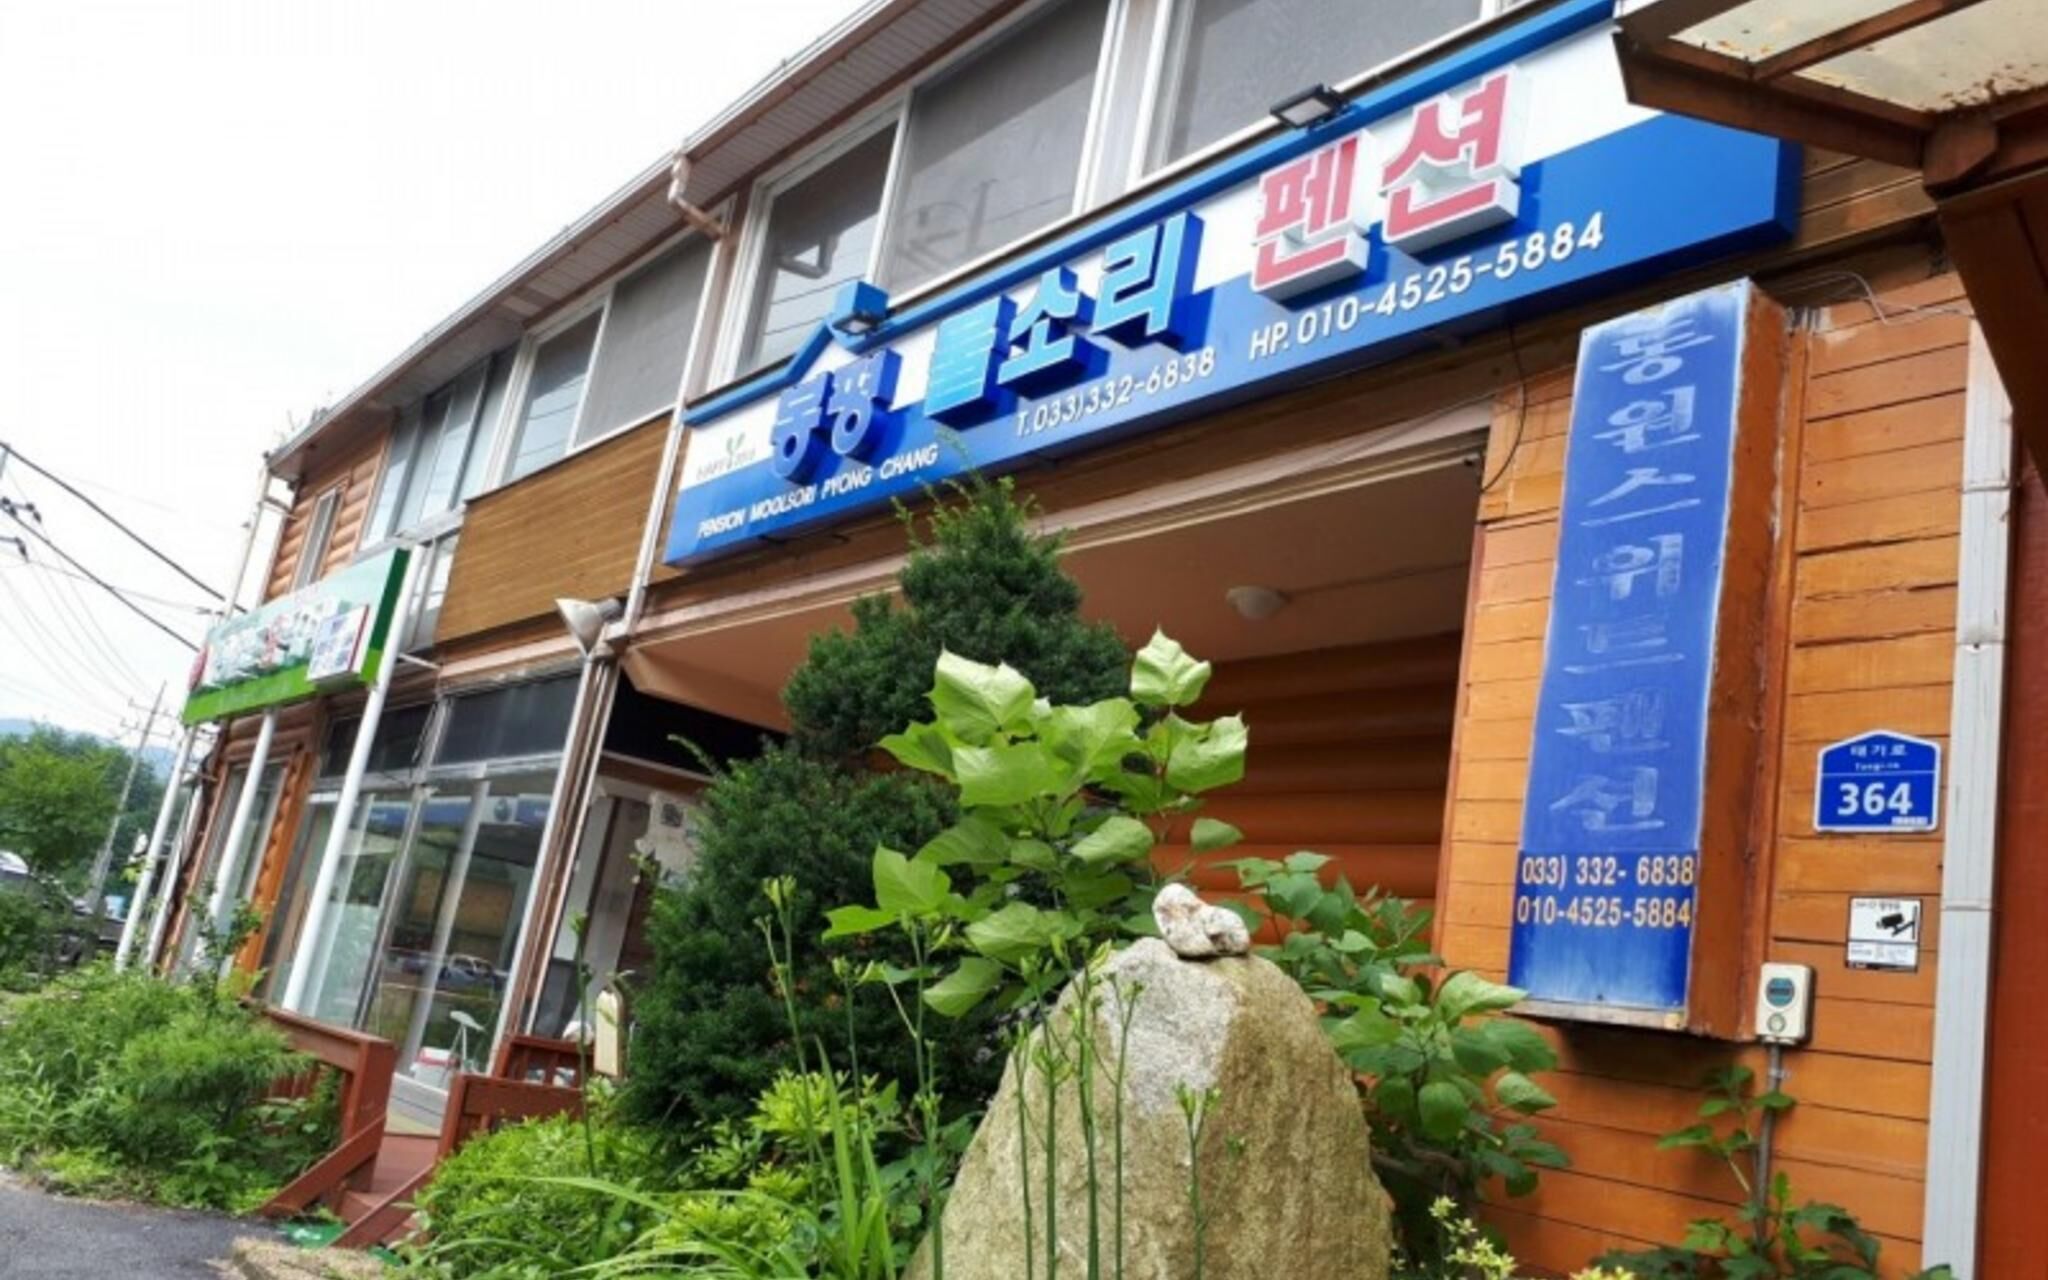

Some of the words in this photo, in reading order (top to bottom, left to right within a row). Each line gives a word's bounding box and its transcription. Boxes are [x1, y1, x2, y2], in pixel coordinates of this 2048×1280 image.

[923, 211, 1195, 418] 물소리
[1250, 64, 1516, 294] 펜션
[697, 508, 746, 539] PENSION
[751, 484, 816, 523] MOOLSORI
[821, 465, 873, 500] PYONG
[879, 443, 939, 480] CHANG
[1837, 782, 1913, 816] 364
[1522, 855, 1568, 891] 033)
[1636, 855, 1695, 886] 6838
[1517, 895, 1692, 928] 010-4525-5884
